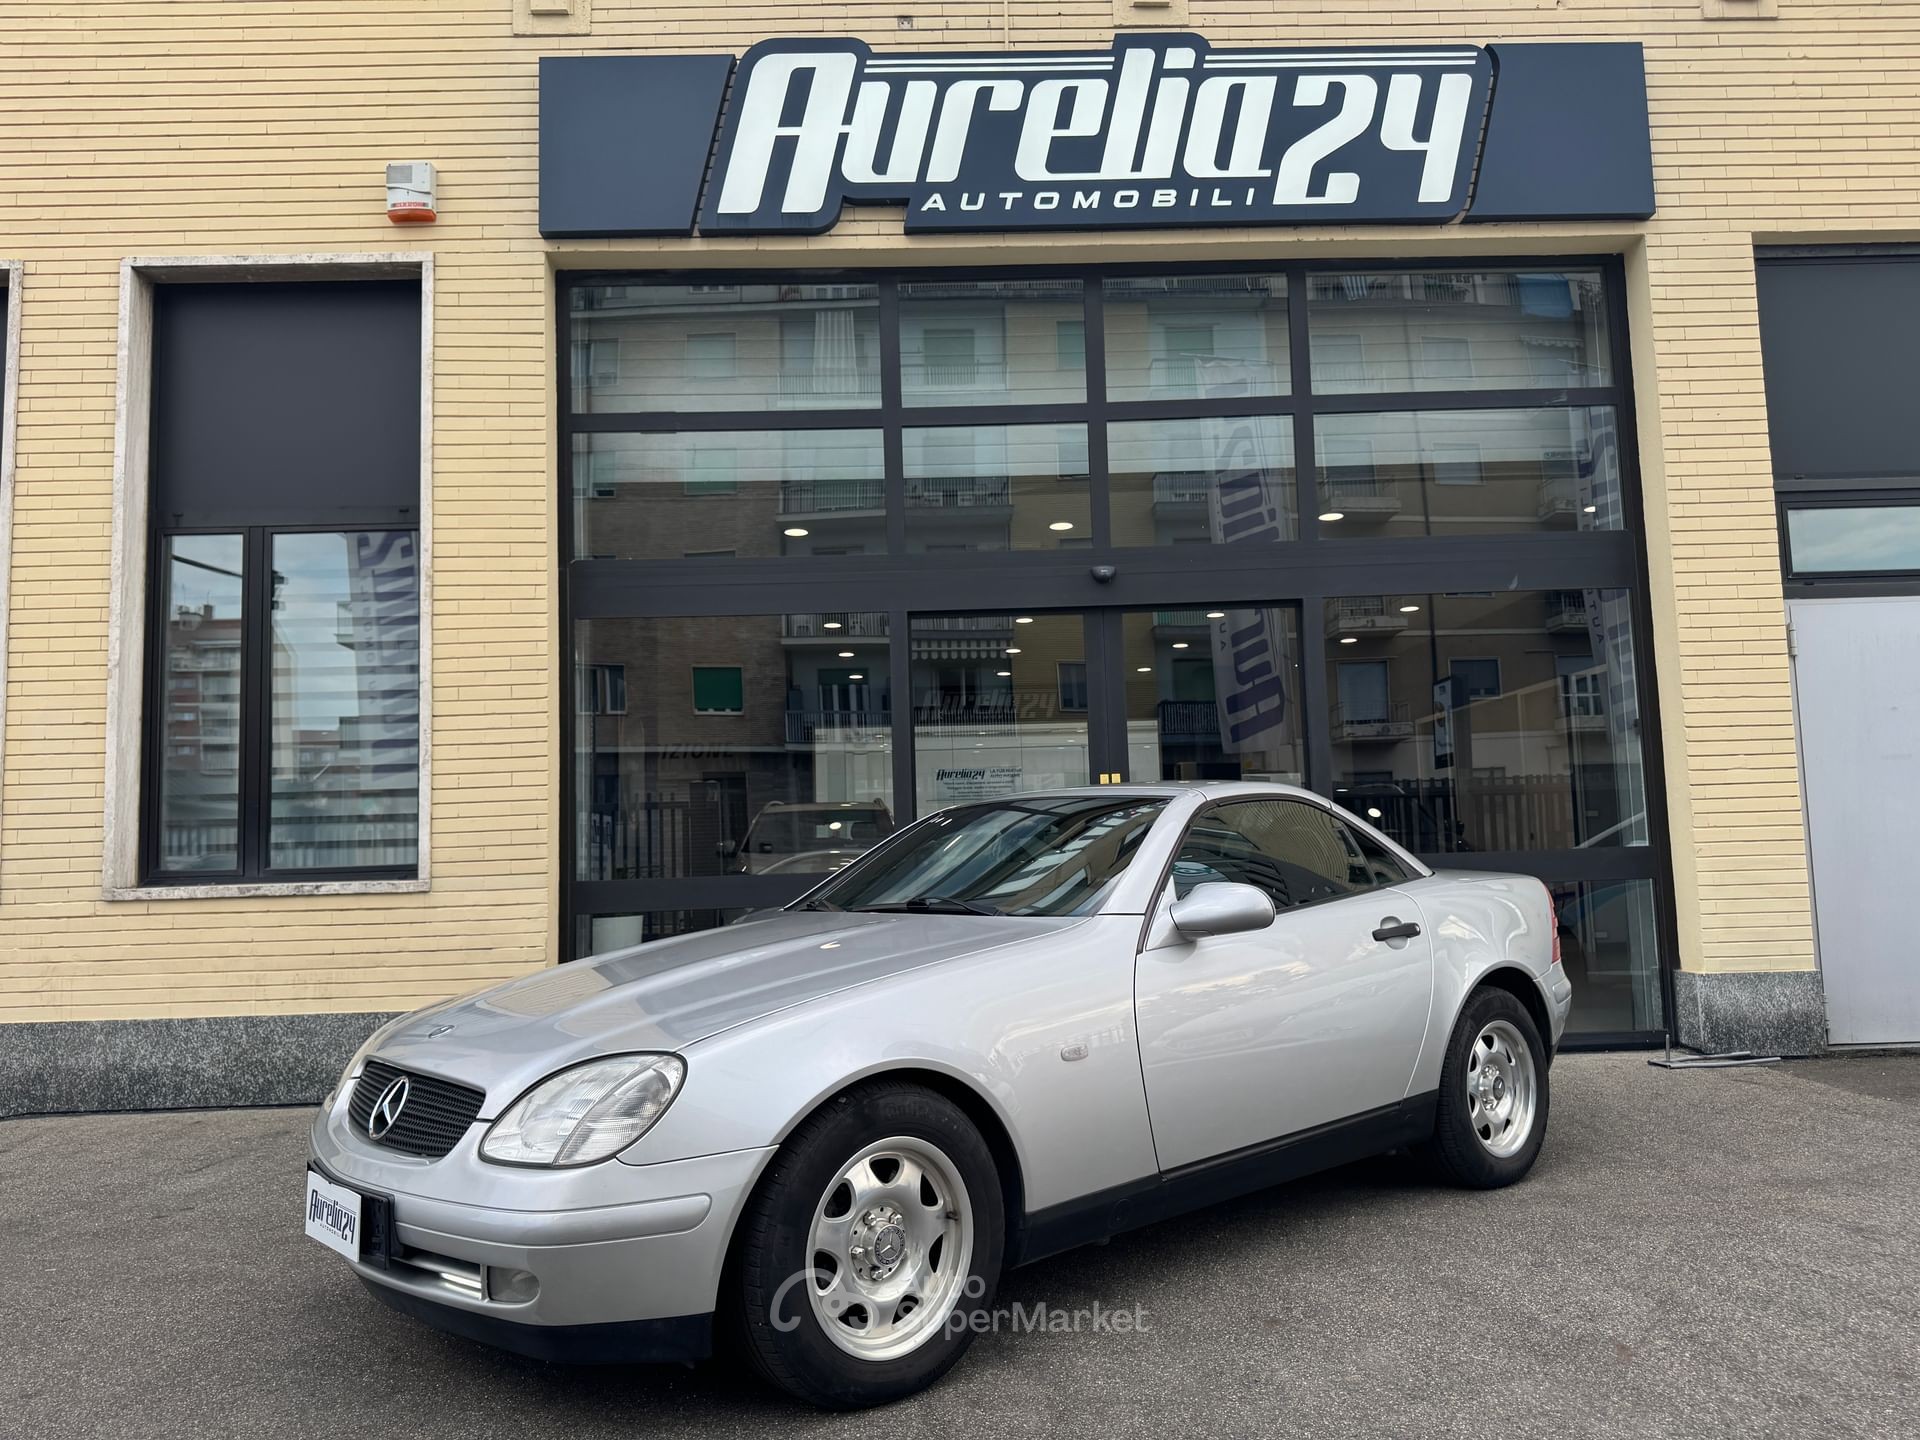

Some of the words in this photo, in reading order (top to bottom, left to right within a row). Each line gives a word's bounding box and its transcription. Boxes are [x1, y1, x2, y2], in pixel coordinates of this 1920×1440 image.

[717, 47, 1473, 214] Aurelia24
[920, 186, 1256, 211] AUTOMOBILI
[936, 768, 985, 780] Aurelia24
[308, 1188, 356, 1245] Aurelia24
